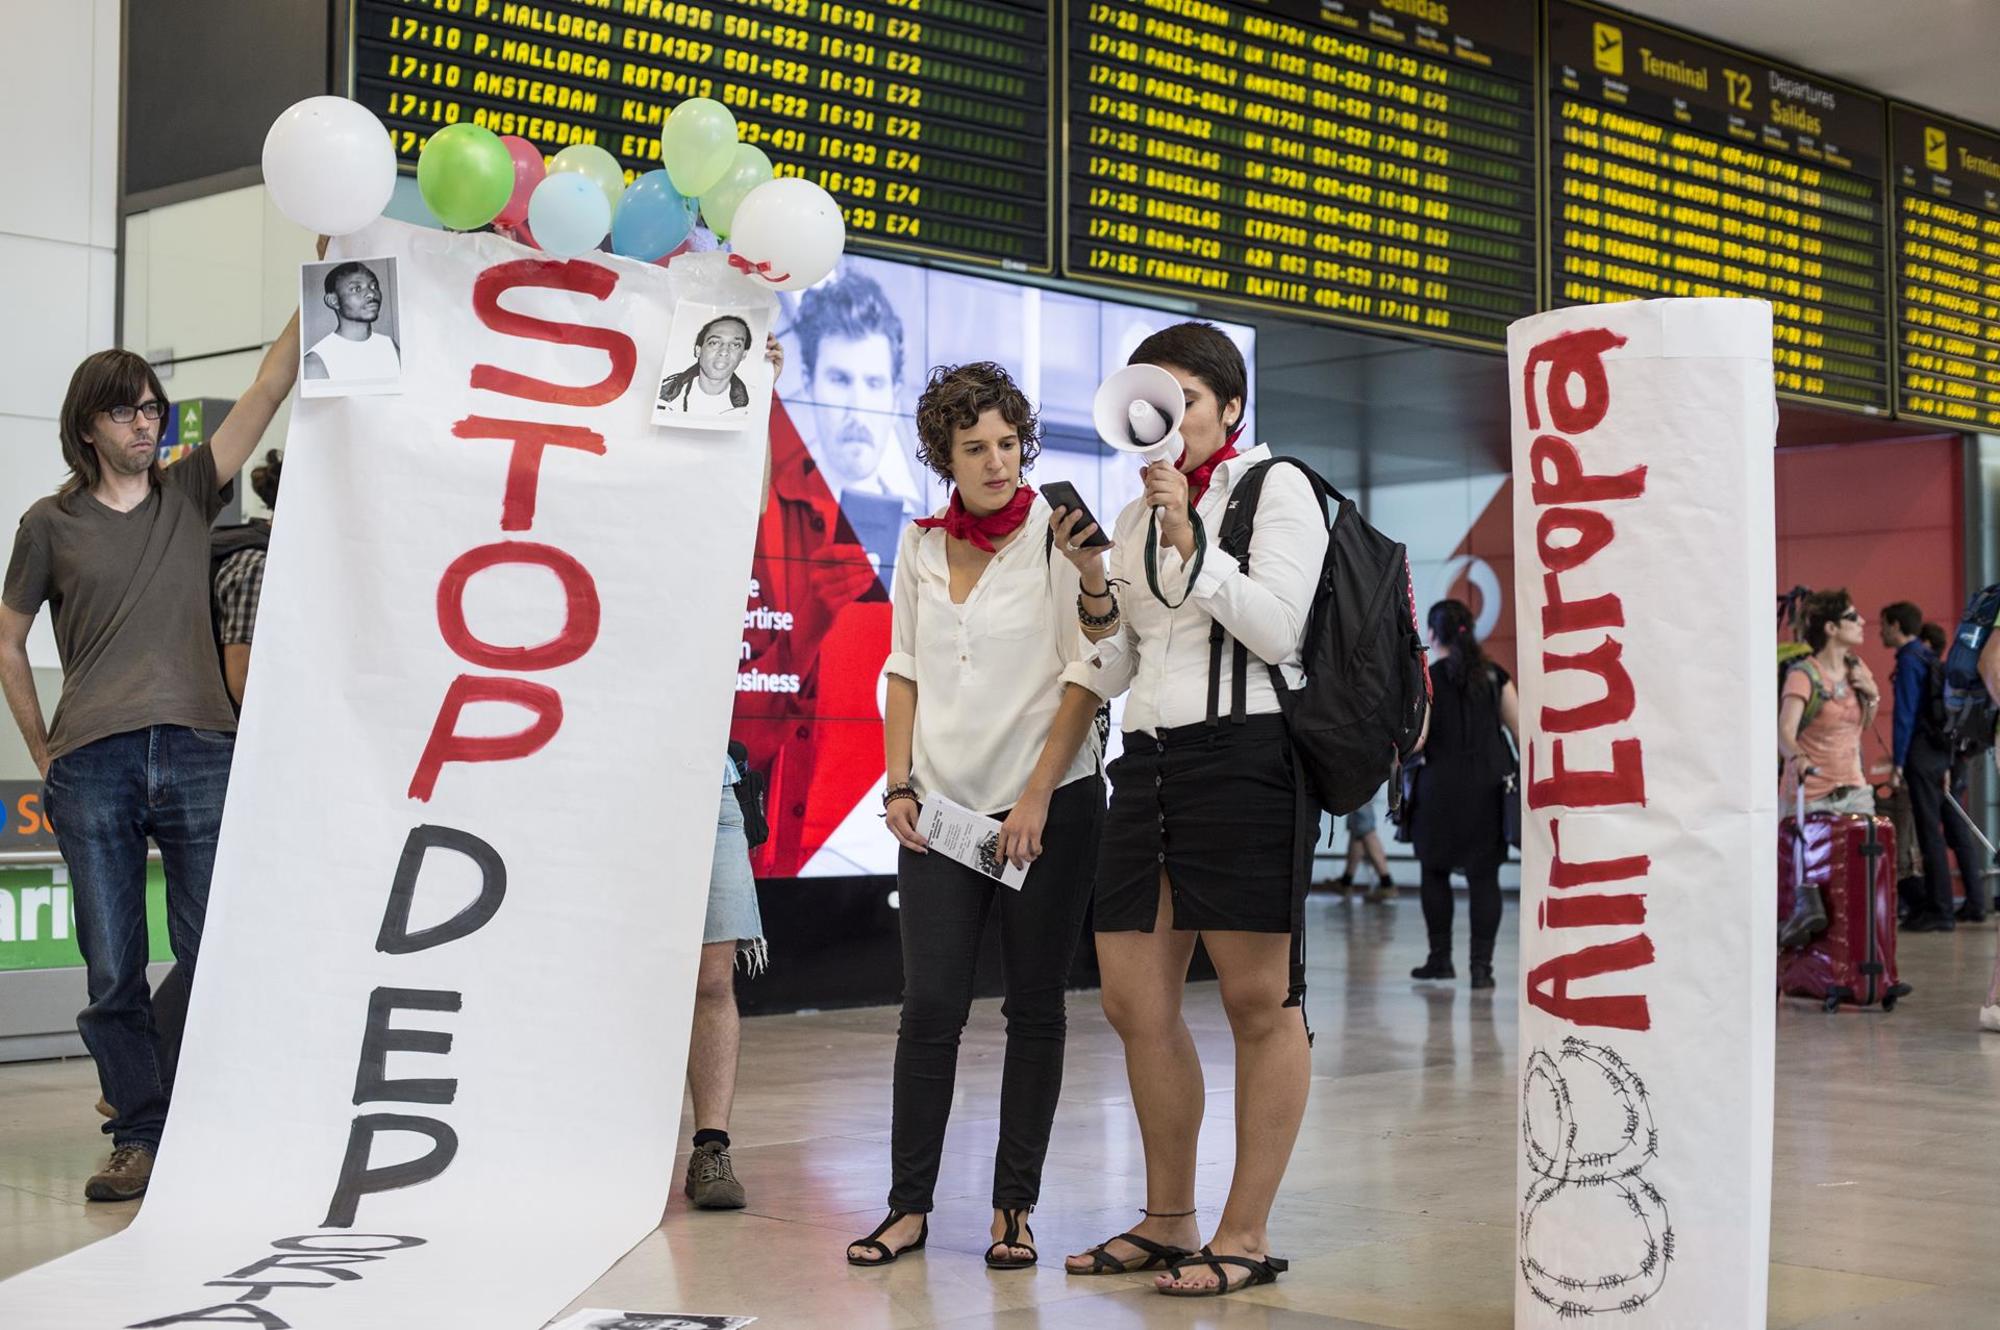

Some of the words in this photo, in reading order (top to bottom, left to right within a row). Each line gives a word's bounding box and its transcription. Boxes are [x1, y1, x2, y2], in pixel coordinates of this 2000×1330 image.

[820, 2, 875, 33] 16:31
[886, 18, 922, 43] E72
[1089, 4, 1139, 32] 17:20
[724, 14, 809, 51] 501-522
[819, 36, 875, 66] 16:31
[886, 50, 922, 76] E72
[1089, 34, 1139, 61] 17:20
[389, 16, 461, 50] 17:10
[474, 33, 611, 80] P.MALLORCA
[723, 83, 809, 119] 501-522
[819, 103, 875, 132] 16:31
[885, 116, 921, 141] E72
[723, 48, 809, 85] 501-522
[819, 69, 875, 98] 16:31
[886, 83, 922, 108] E72
[1089, 66, 1139, 92] 17:20
[1639, 47, 1708, 92] Terminal
[1722, 67, 1753, 110] T2
[1768, 70, 1836, 110] Departures
[388, 54, 461, 88] 17:10
[473, 71, 598, 113] AMSTERDAM
[818, 136, 877, 165] 16:33
[885, 149, 921, 173] E74
[1089, 95, 1139, 122] 17:35
[1770, 99, 1822, 135] Salidas
[388, 93, 460, 126] 17:10
[473, 107, 597, 148] AMSTERDAM
[818, 170, 877, 199] 16:33
[885, 182, 920, 206] E74
[1089, 127, 1138, 153] 17:35
[1089, 157, 1138, 183] 17:35
[1089, 188, 1139, 214] 17:35
[885, 213, 920, 237] E74
[1089, 250, 1139, 274] 17:55
[1145, 258, 1229, 289] FRANKFURT
[407, 259, 637, 803] STOP
